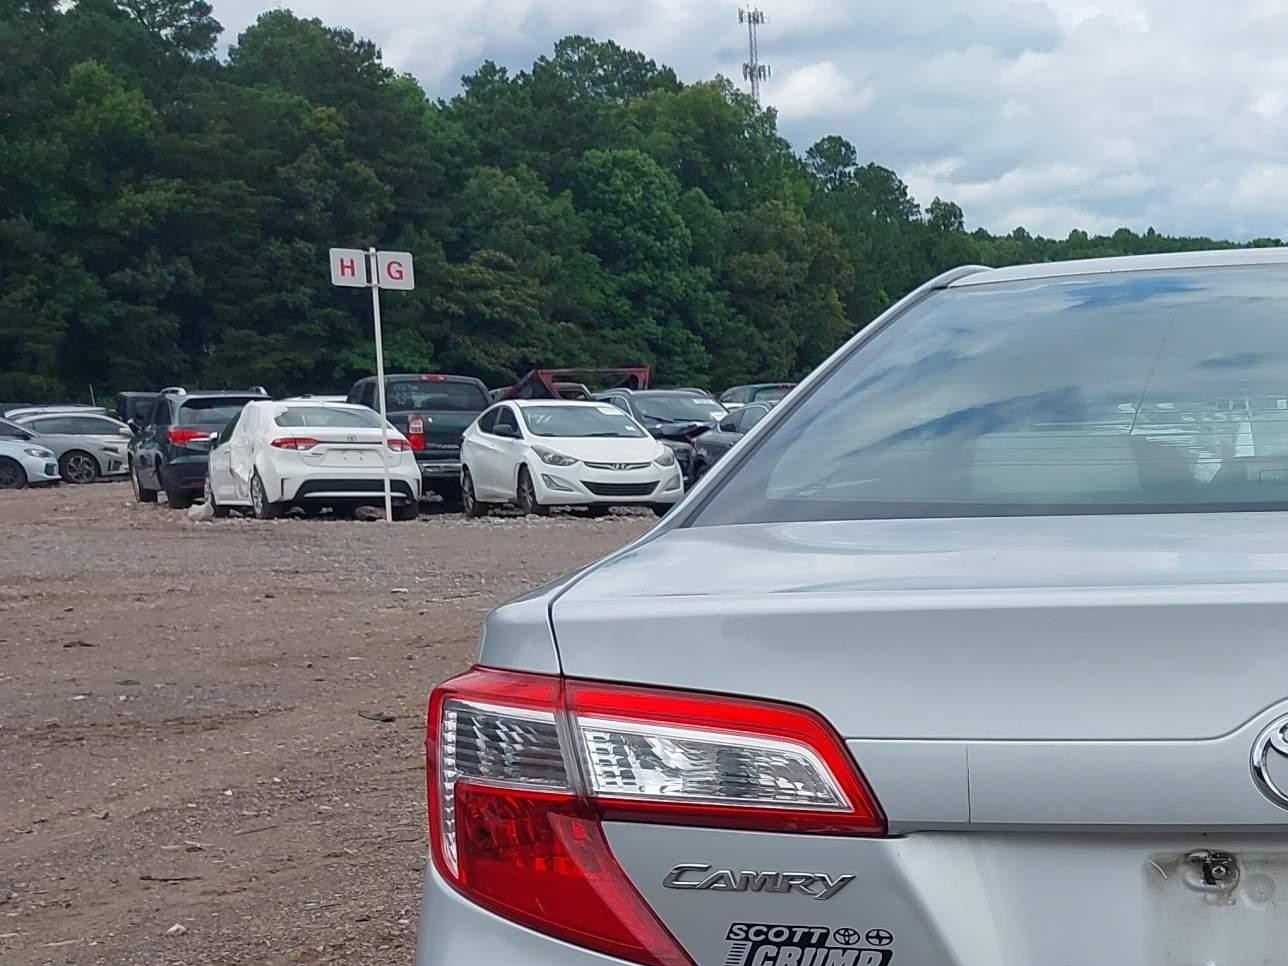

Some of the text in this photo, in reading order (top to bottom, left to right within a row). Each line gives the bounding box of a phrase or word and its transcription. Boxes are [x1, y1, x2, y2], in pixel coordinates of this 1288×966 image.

[339, 258, 356, 277] H
[386, 260, 404, 280] G
[662, 863, 857, 901] CAMRY
[729, 923, 829, 944] SCOTT
